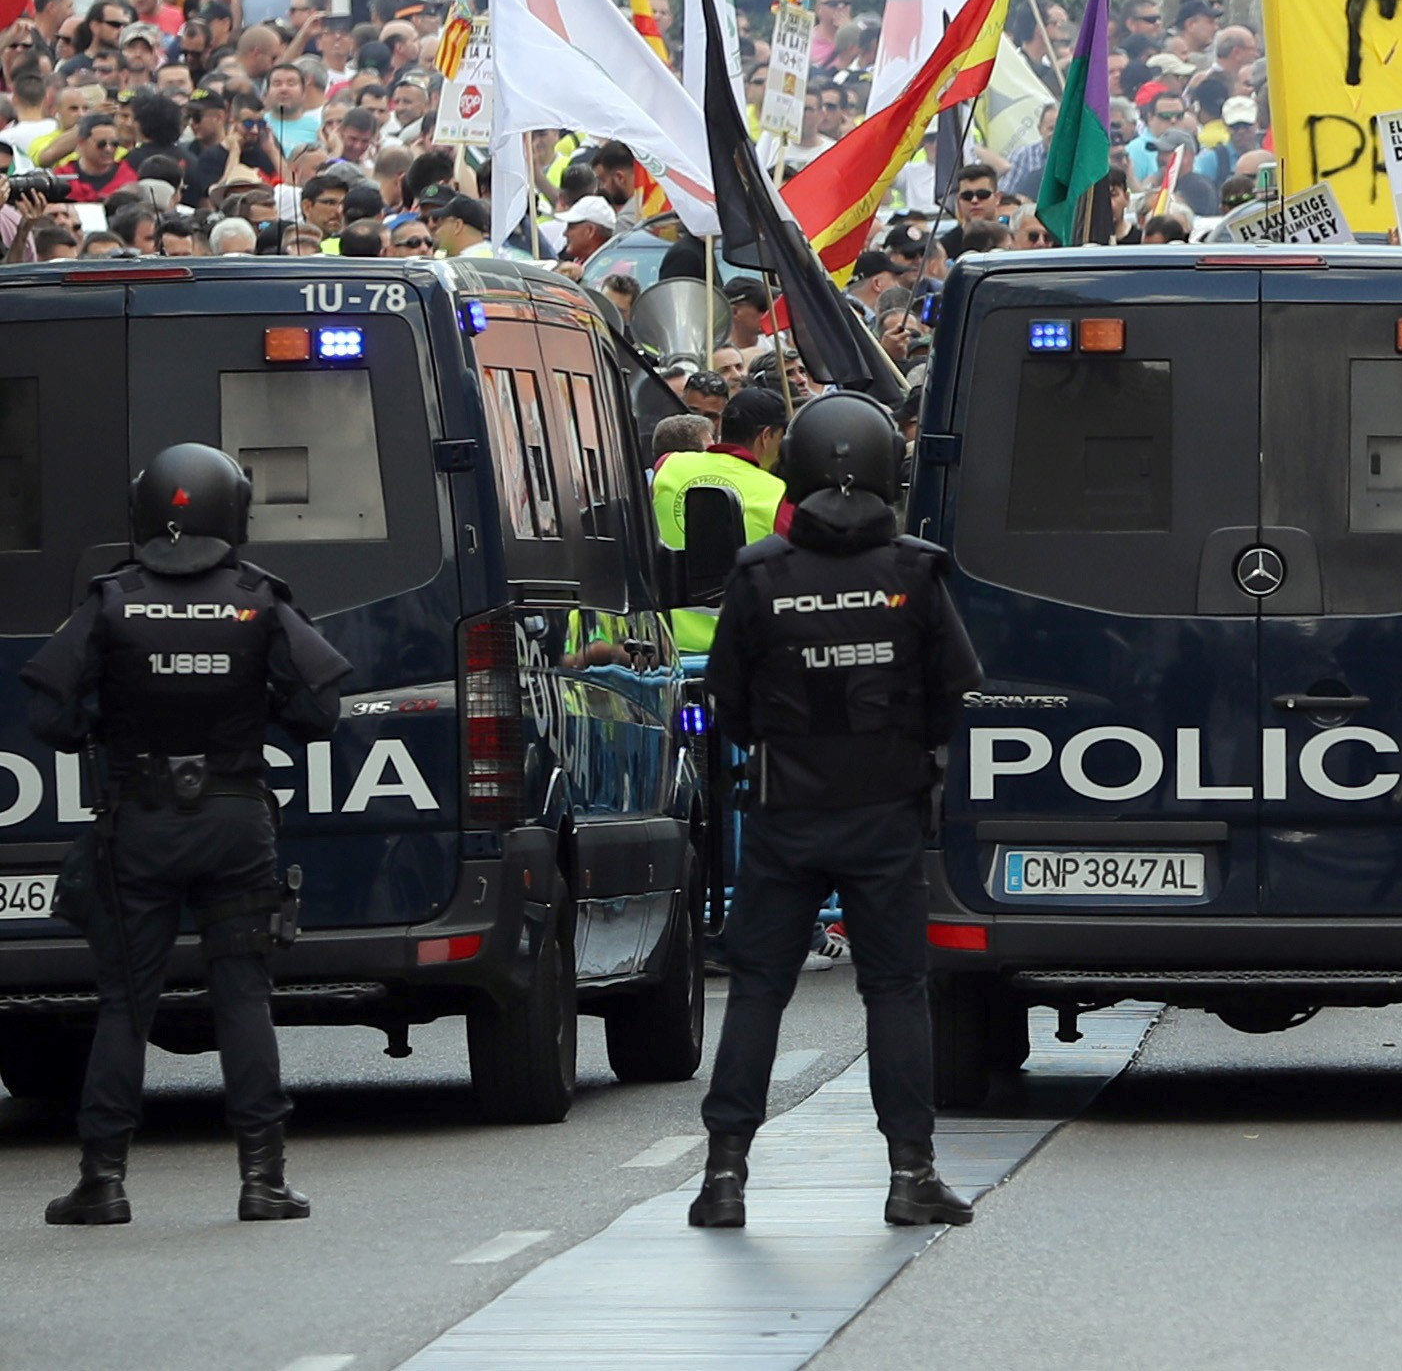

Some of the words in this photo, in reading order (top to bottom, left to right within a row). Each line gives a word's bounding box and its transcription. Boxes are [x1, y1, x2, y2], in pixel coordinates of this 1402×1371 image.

[1391, 135, 1402, 145] EL
[1240, 225, 1256, 241] EL
[1289, 194, 1328, 220] EXIGE
[1308, 218, 1339, 243] LEY
[299, 282, 407, 313] 1U-78
[123, 603, 239, 621] POLICIA
[772, 590, 890, 615] POLICIA
[148, 653, 231, 674] 1U883
[350, 699, 392, 716] 315
